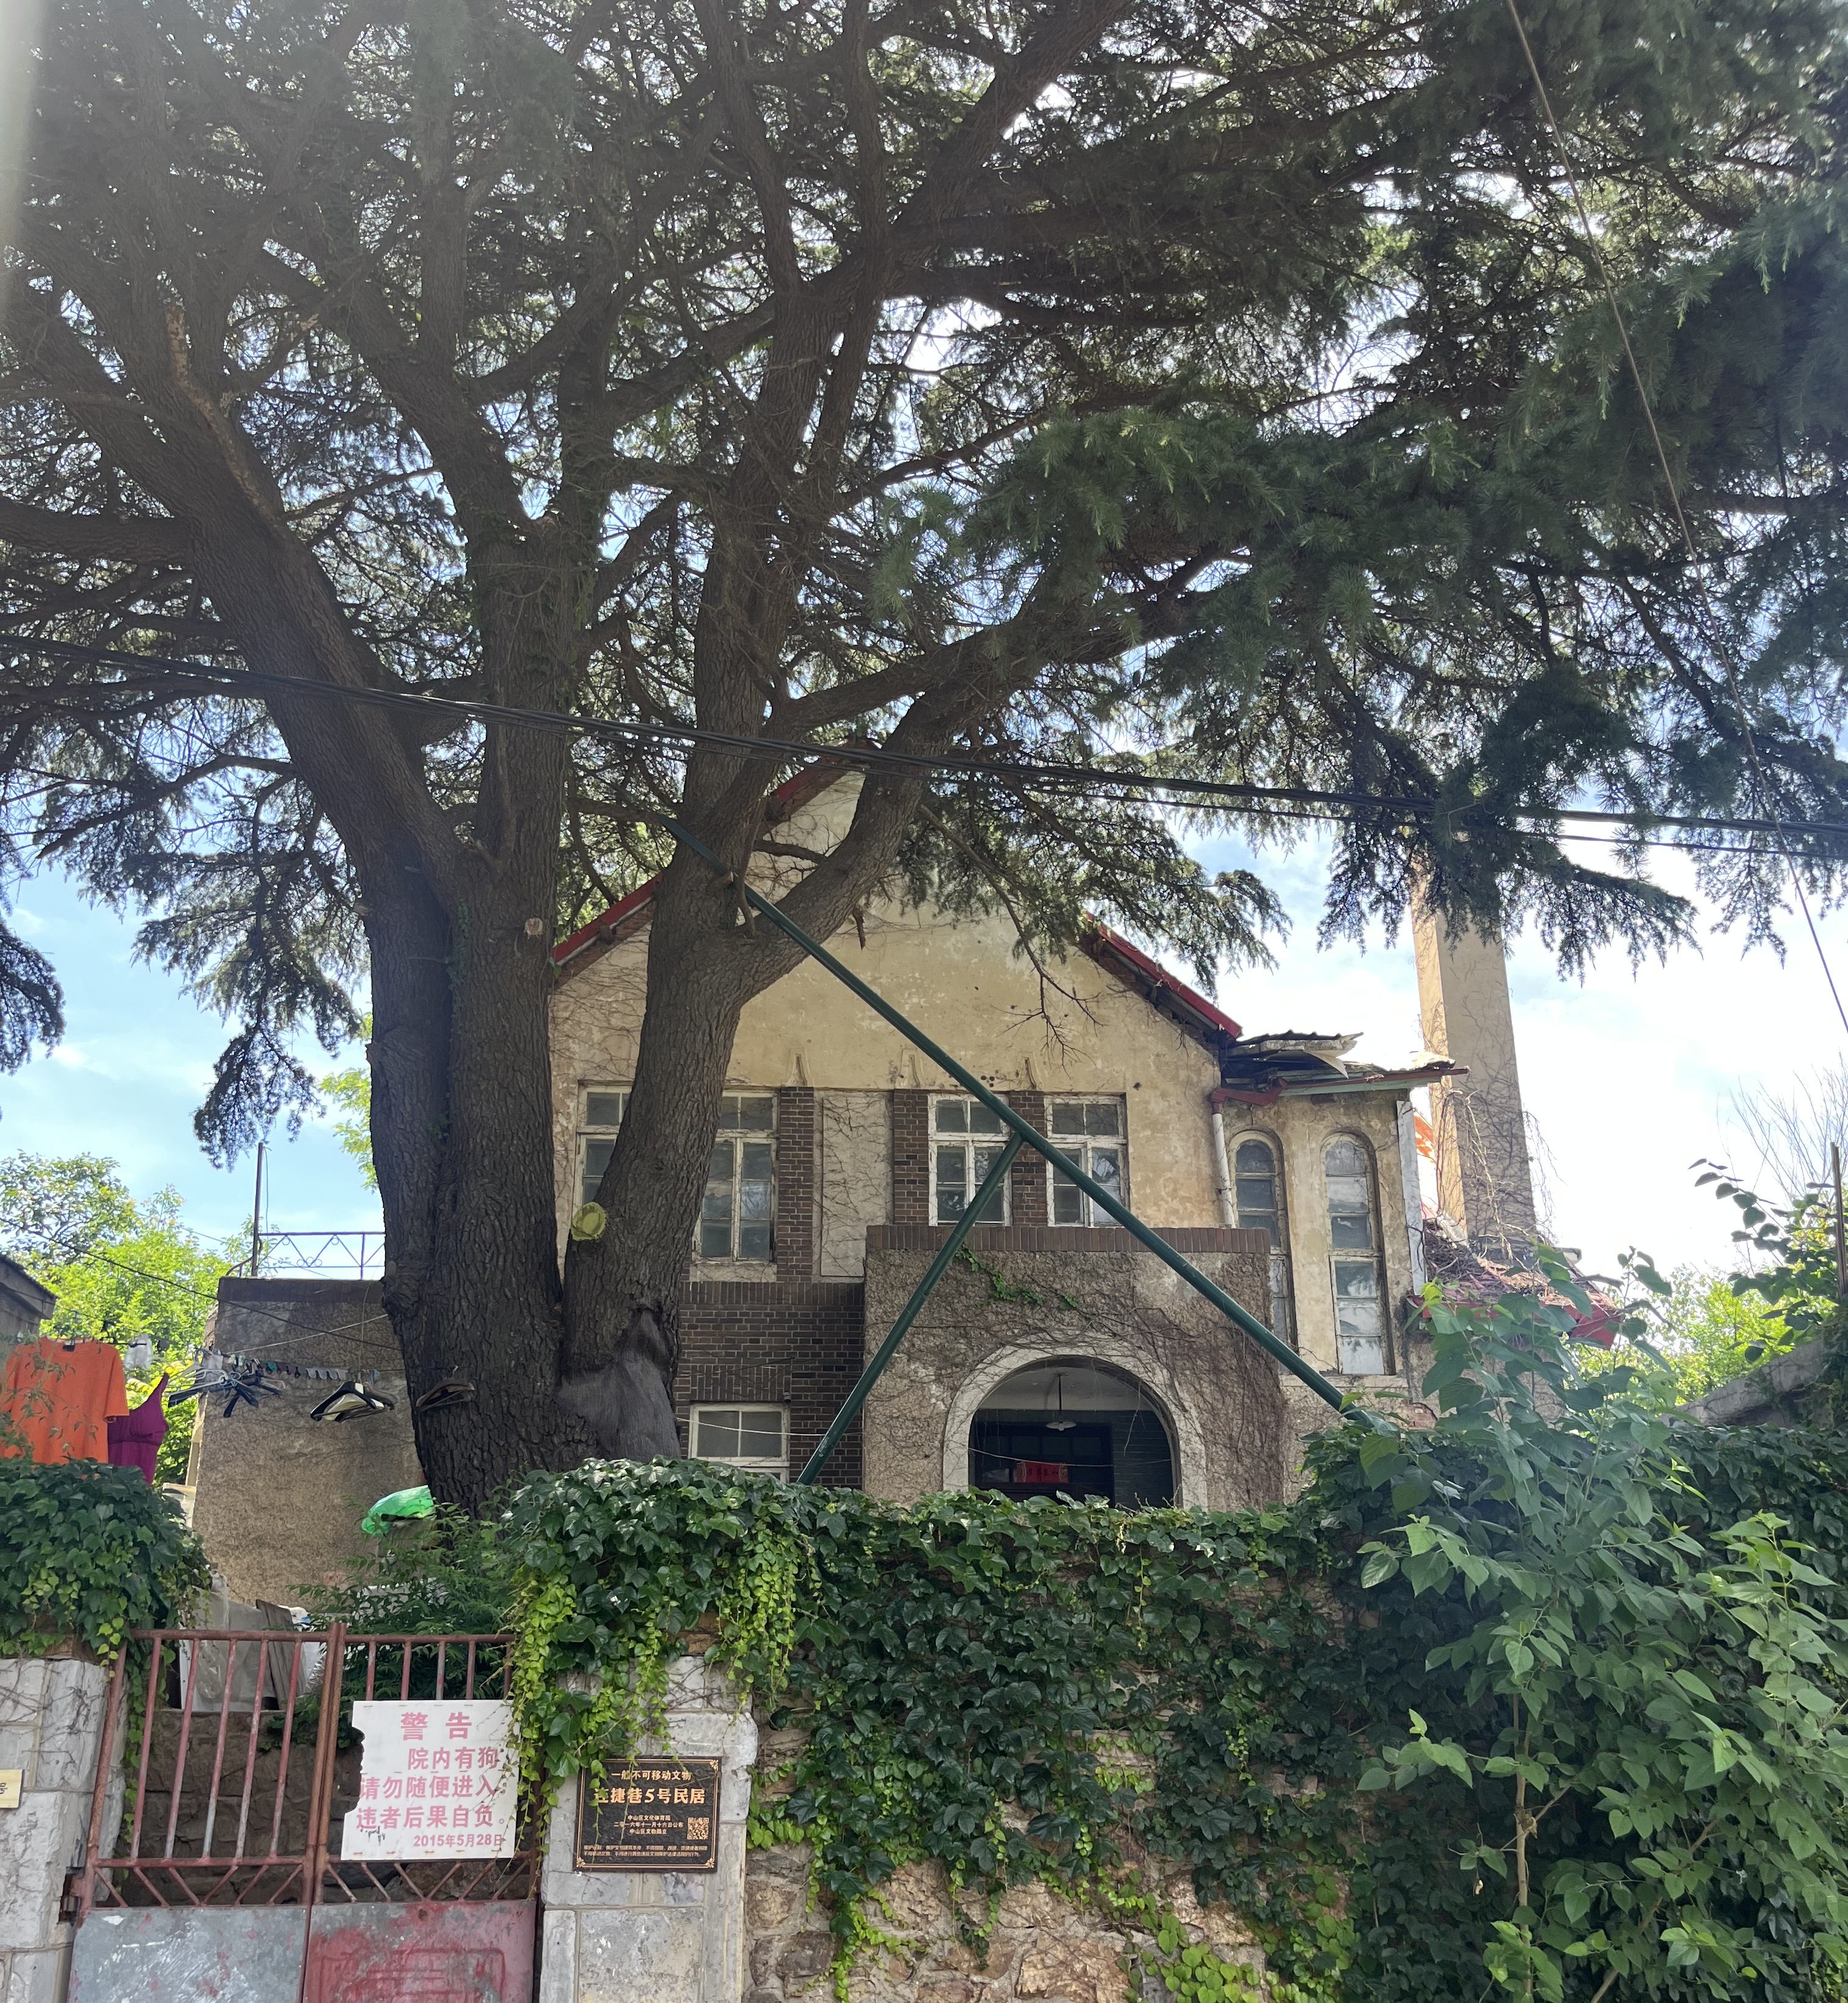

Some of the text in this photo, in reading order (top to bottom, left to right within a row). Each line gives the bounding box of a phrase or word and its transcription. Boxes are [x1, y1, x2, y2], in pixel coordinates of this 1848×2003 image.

[401, 1712, 472, 1741] 警告
[408, 1746, 499, 1770] 院内有狗
[357, 1804, 504, 1829] 违者后果自负。
[413, 1834, 502, 1848] 2015年5月28日
